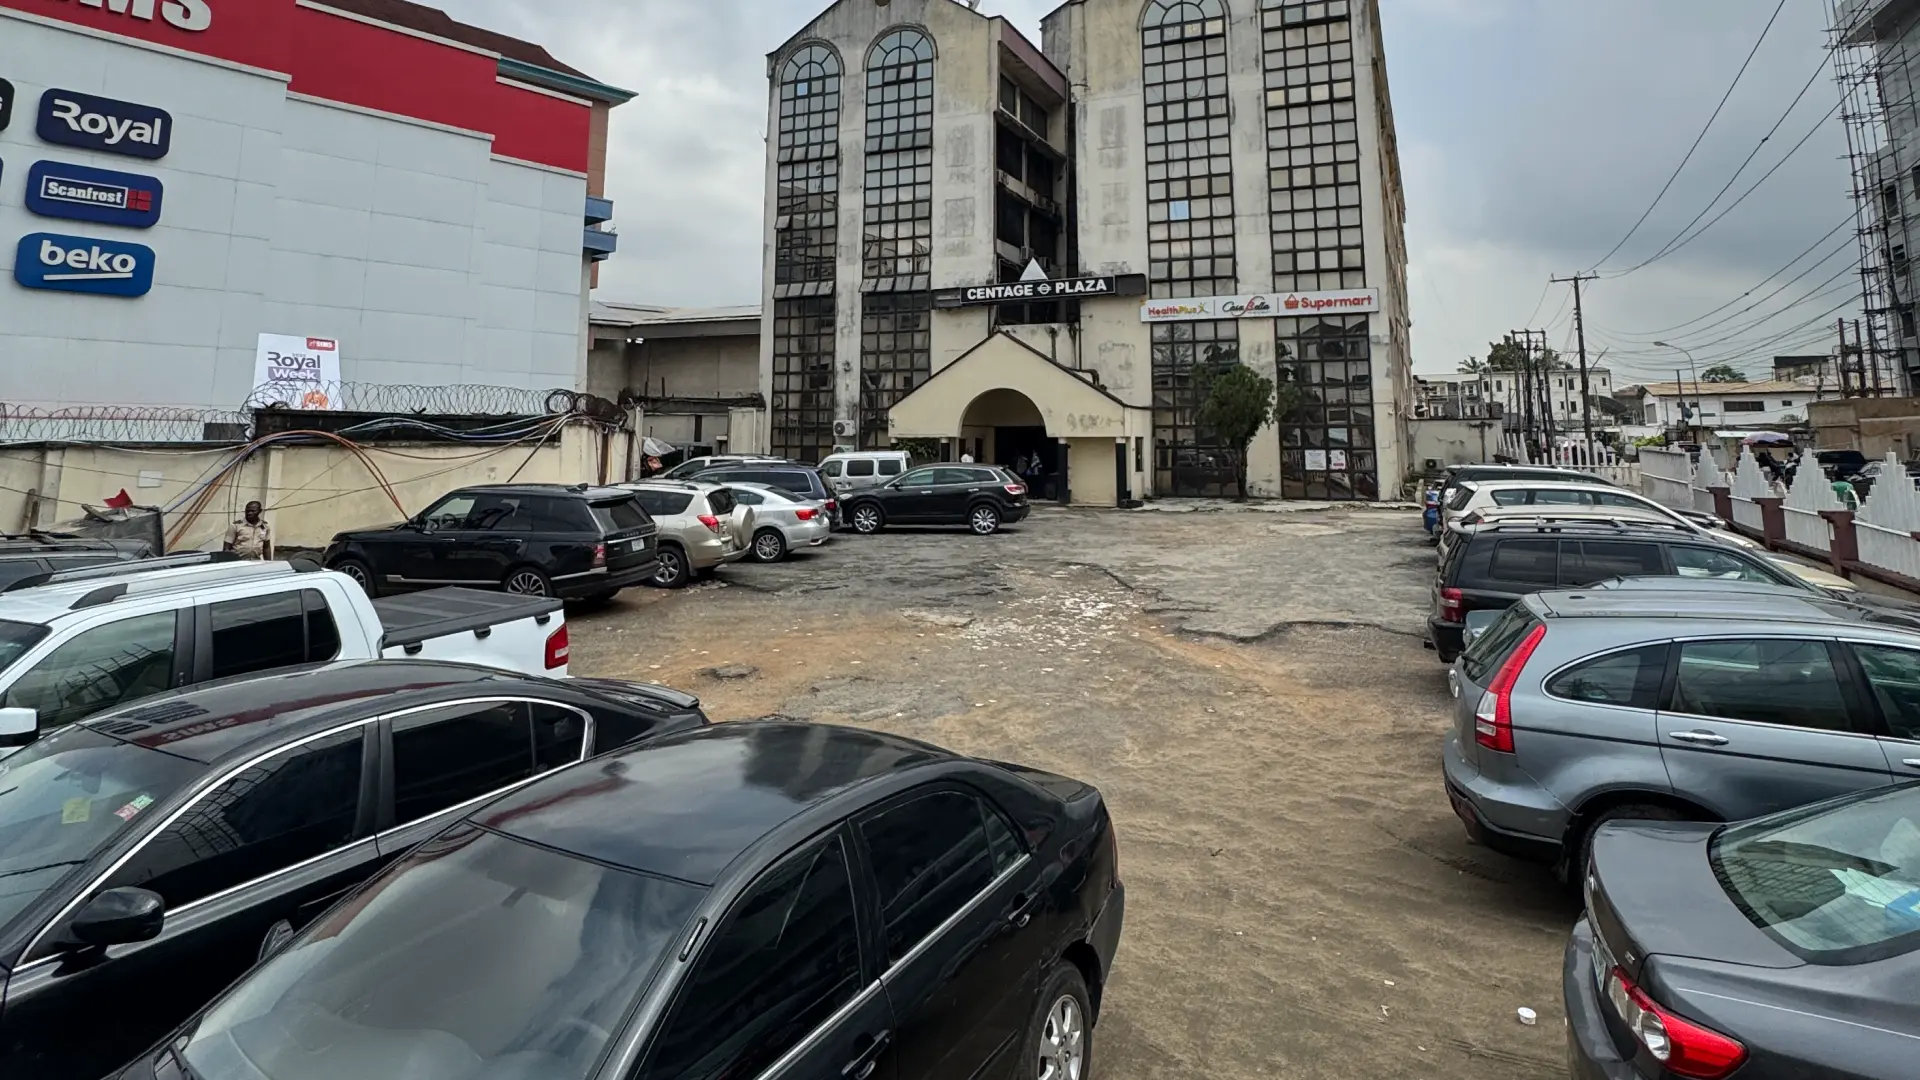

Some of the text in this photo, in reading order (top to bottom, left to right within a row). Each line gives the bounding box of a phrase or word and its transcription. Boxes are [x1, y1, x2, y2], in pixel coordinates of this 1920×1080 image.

[52, 98, 162, 145] Royal
[47, 181, 123, 204] Scanfrost
[39, 239, 136, 272] beko
[966, 279, 1107, 300] CENTAGE PLAZA
[1148, 304, 1197, 316] HealthPlus
[1301, 294, 1372, 311] Supermart
[267, 351, 320, 371] Royal
[273, 368, 316, 379] Week
